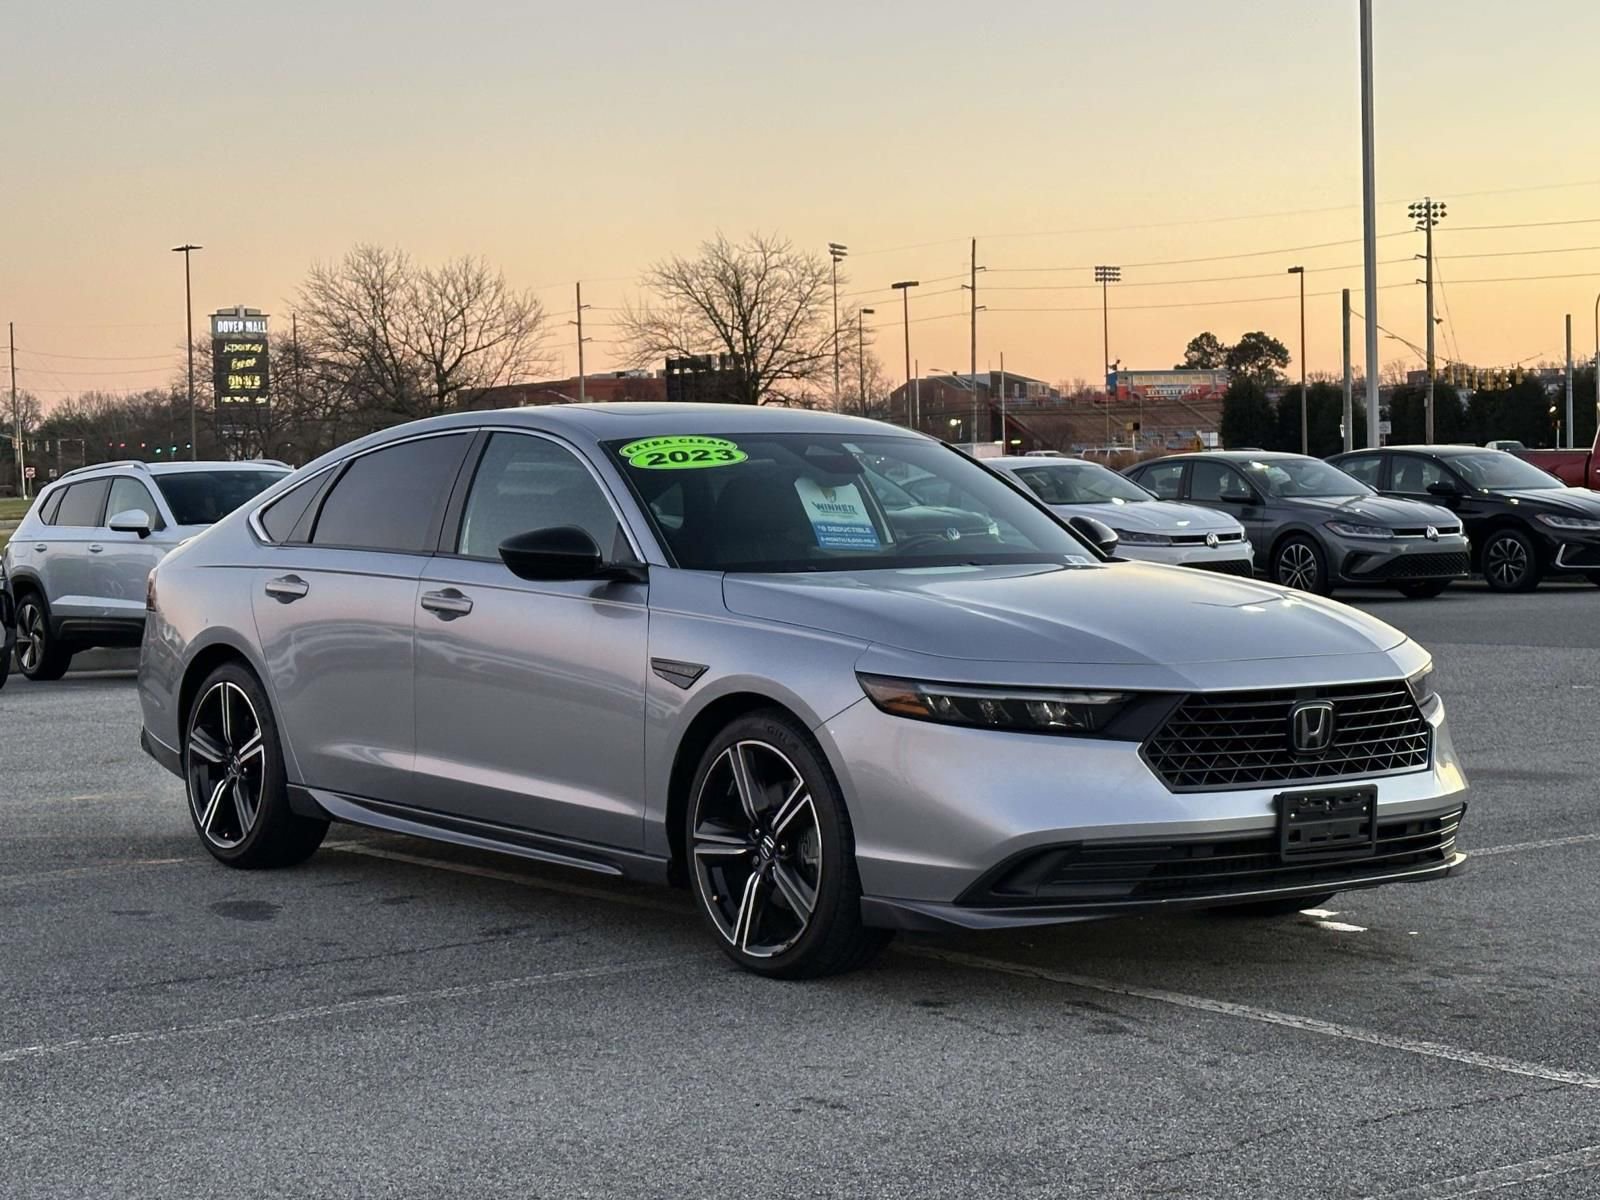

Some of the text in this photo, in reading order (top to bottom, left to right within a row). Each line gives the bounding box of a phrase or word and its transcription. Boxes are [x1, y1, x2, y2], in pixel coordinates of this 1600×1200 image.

[217, 320, 267, 333] DOVER MALL
[626, 438, 729, 454] EXTRA CLEAN
[645, 448, 737, 466] 2023
[813, 502, 857, 514] WINNER
